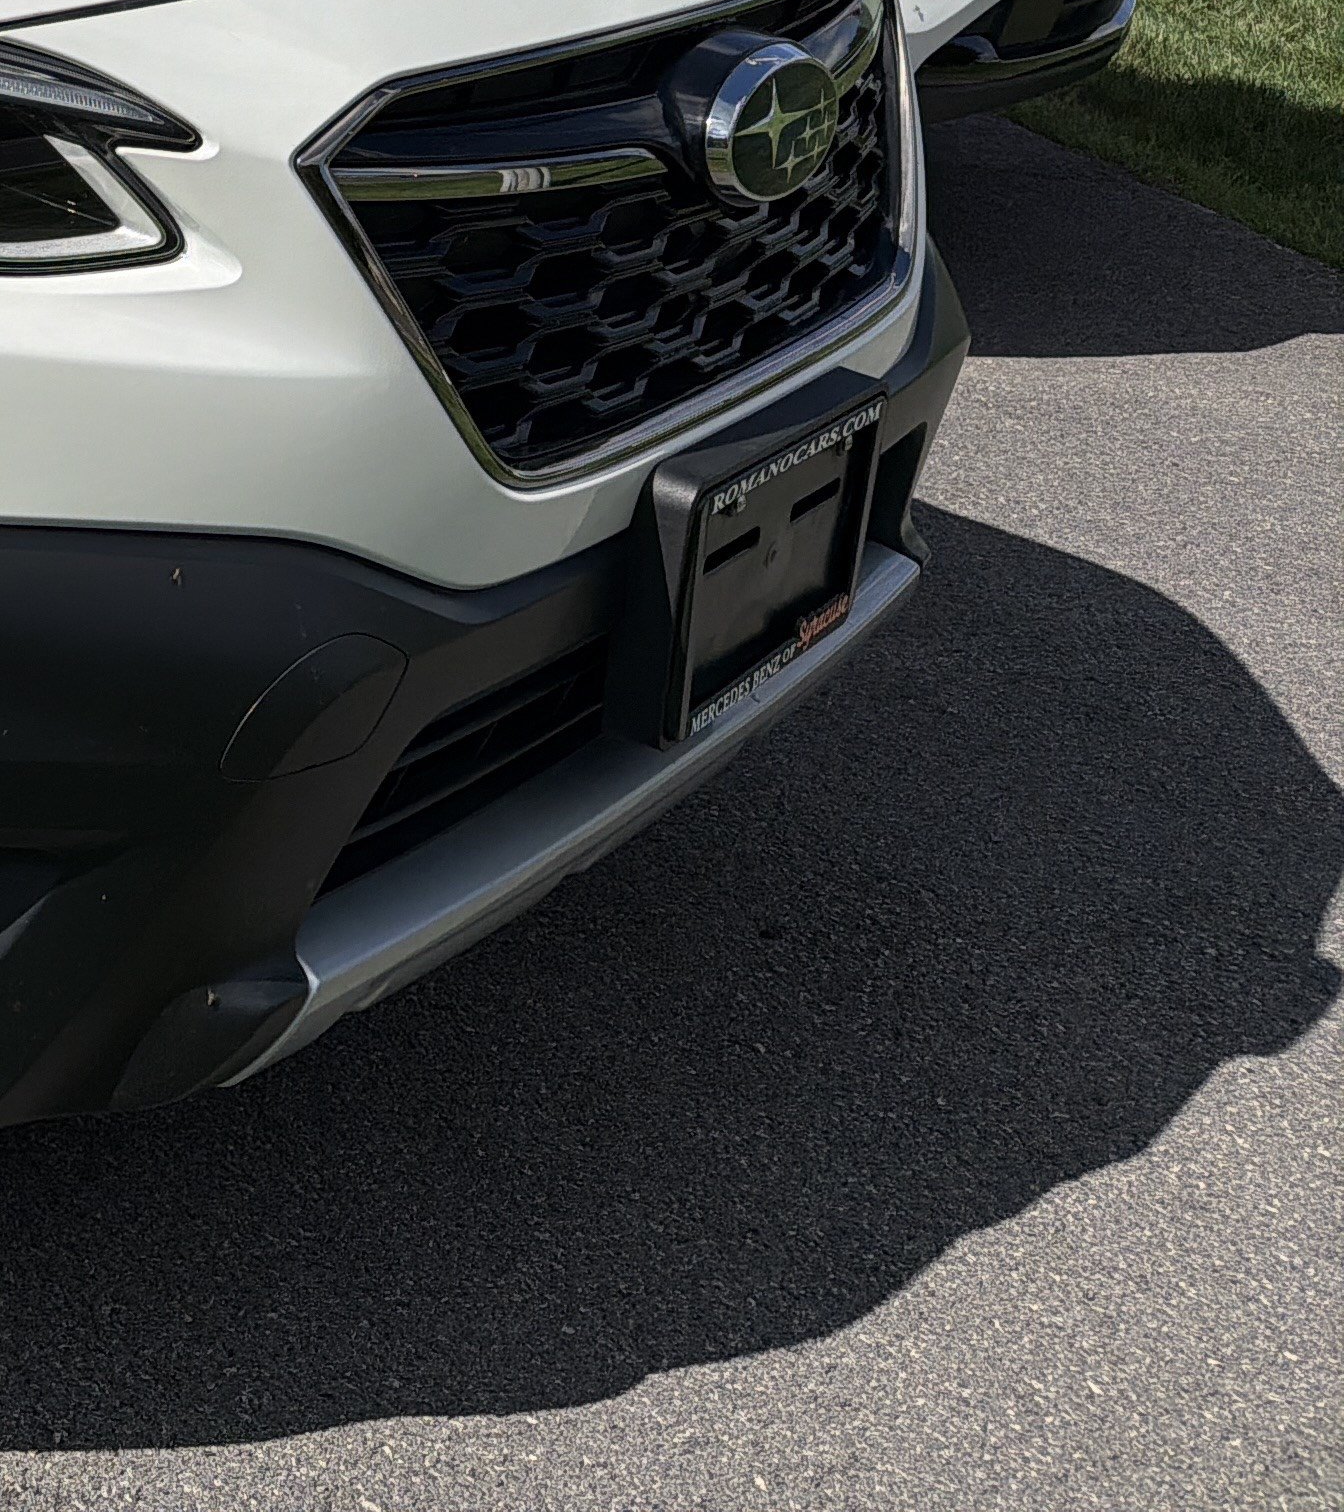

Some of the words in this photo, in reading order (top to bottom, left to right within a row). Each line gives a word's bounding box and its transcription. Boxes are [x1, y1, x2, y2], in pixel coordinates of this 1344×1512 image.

[711, 401, 883, 515] ROMANOCARS.COM
[690, 677, 751, 737] MERCEDES
[752, 653, 782, 691] BENZ
[782, 643, 797, 663] OF
[797, 592, 850, 651] Syracuse
